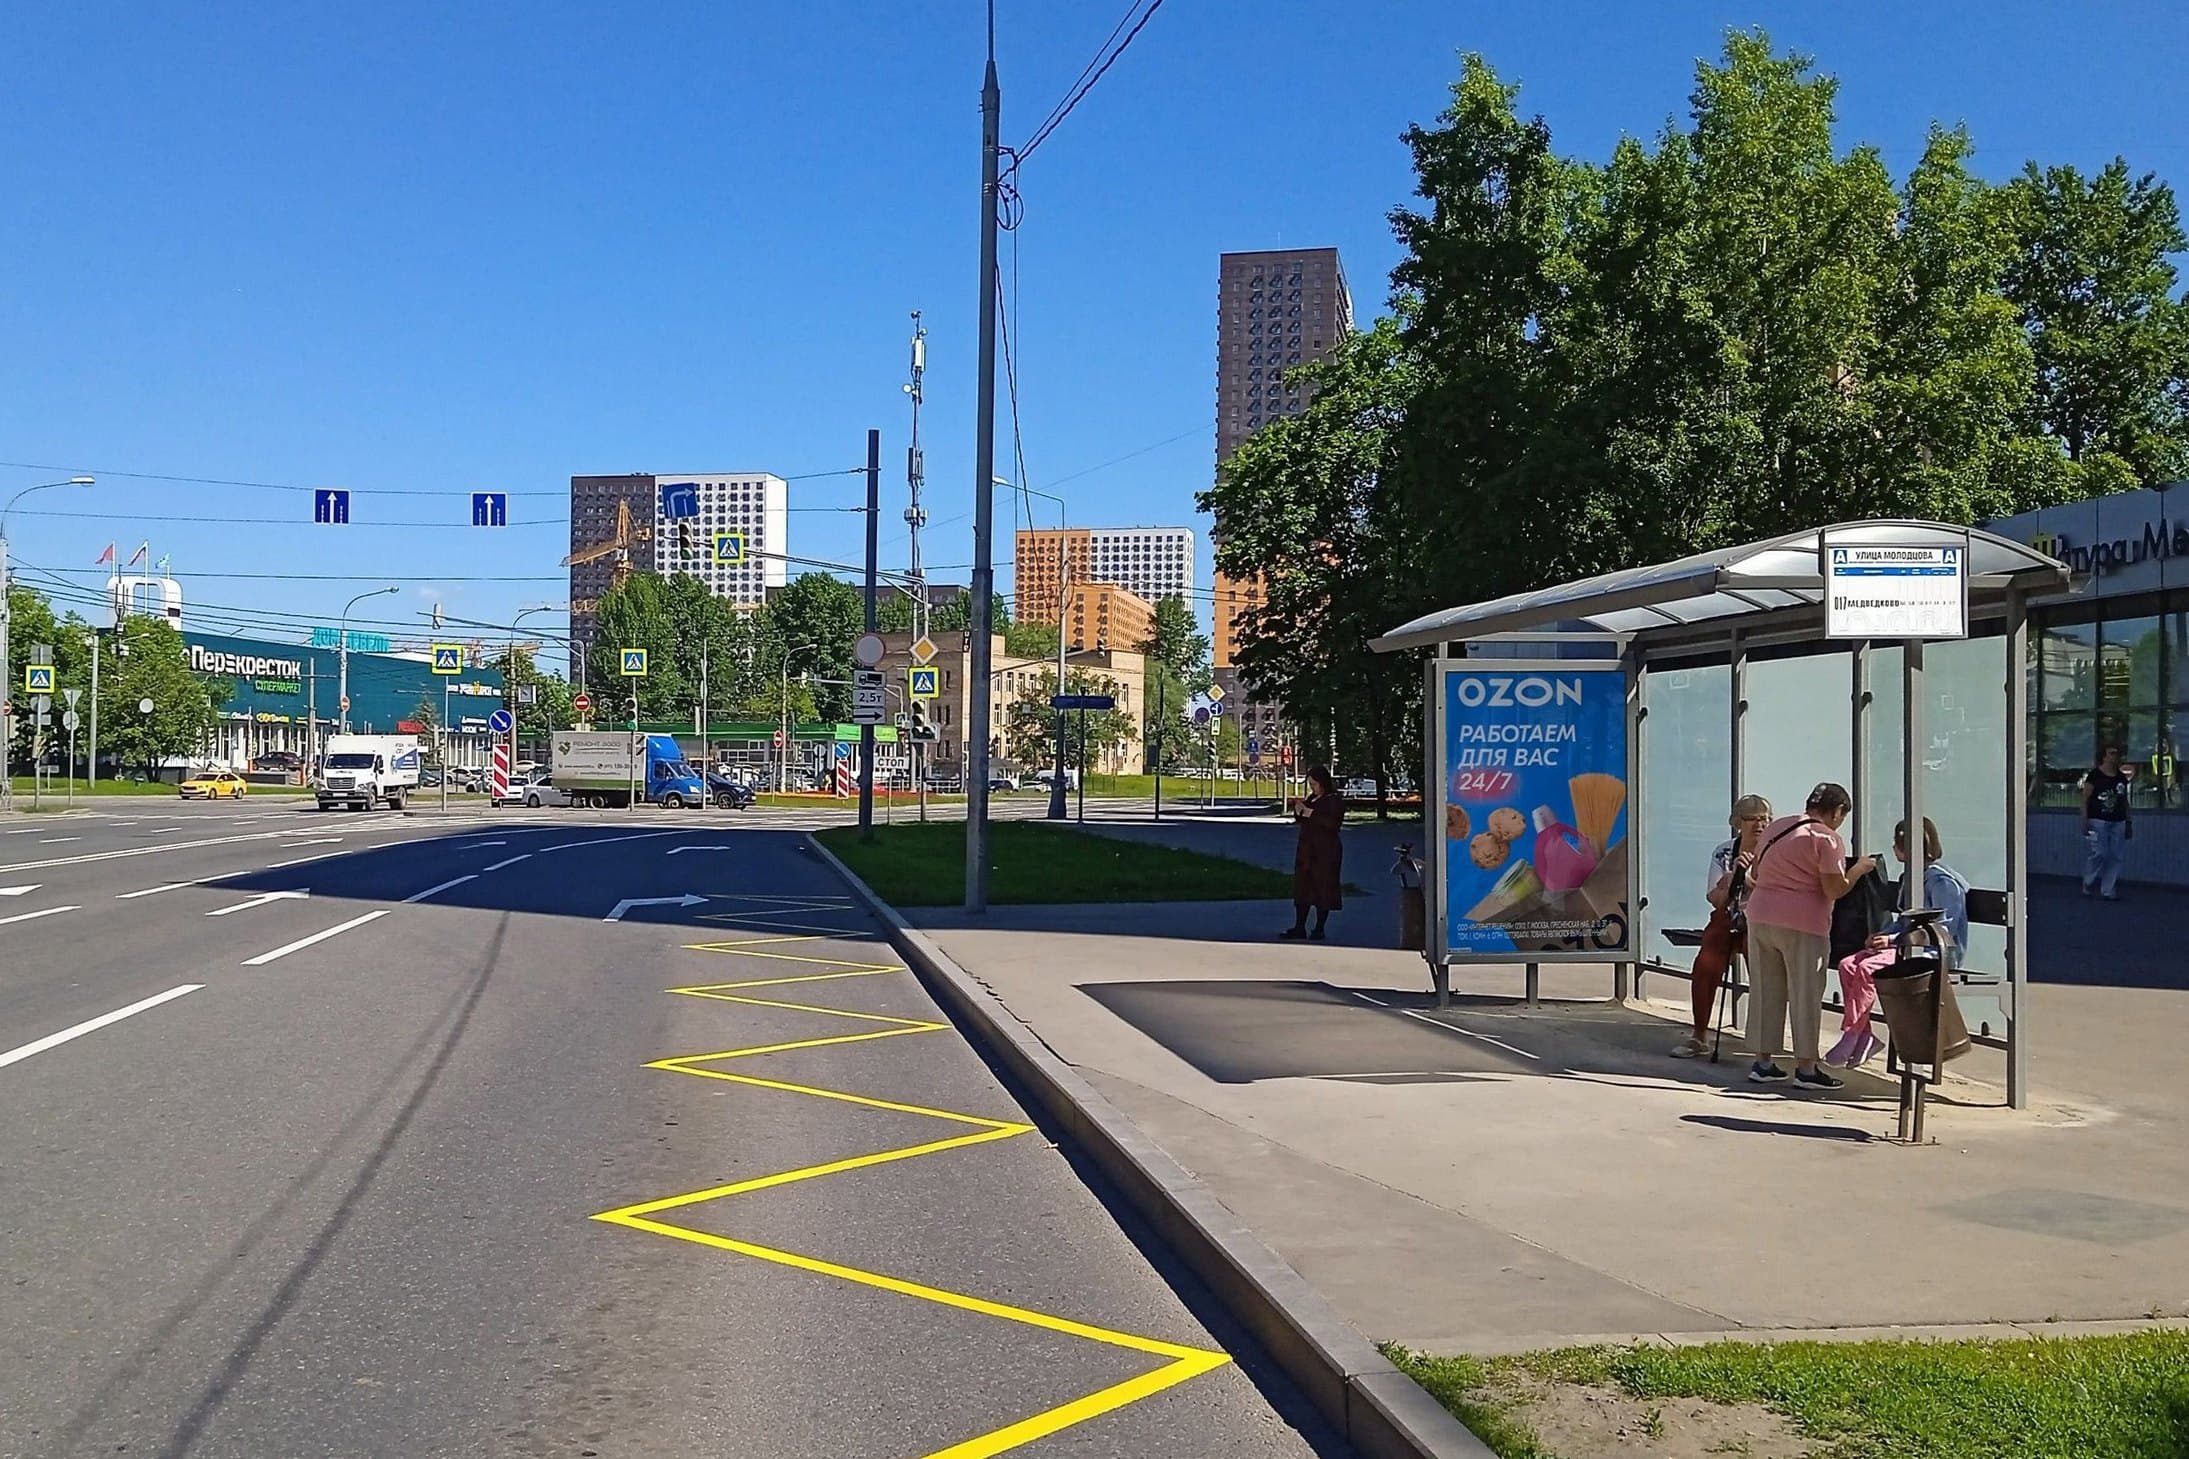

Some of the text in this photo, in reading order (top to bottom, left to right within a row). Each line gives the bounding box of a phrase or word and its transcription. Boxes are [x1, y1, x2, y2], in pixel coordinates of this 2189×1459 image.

[1855, 551, 1933, 560] УЛИЦА МОЛОДЦОВА
[1847, 600, 1900, 608] МЕДВЕДКОВО
[255, 680, 301, 694] СУПЕРМАРКЕТ
[1458, 678, 1582, 707] OZON
[1460, 724, 1576, 743] РАБОТАЕМ
[878, 757, 904, 768] СТОП
[1458, 748, 1559, 770] ДЛЯ ВАС
[1459, 770, 1513, 792] 24/7
